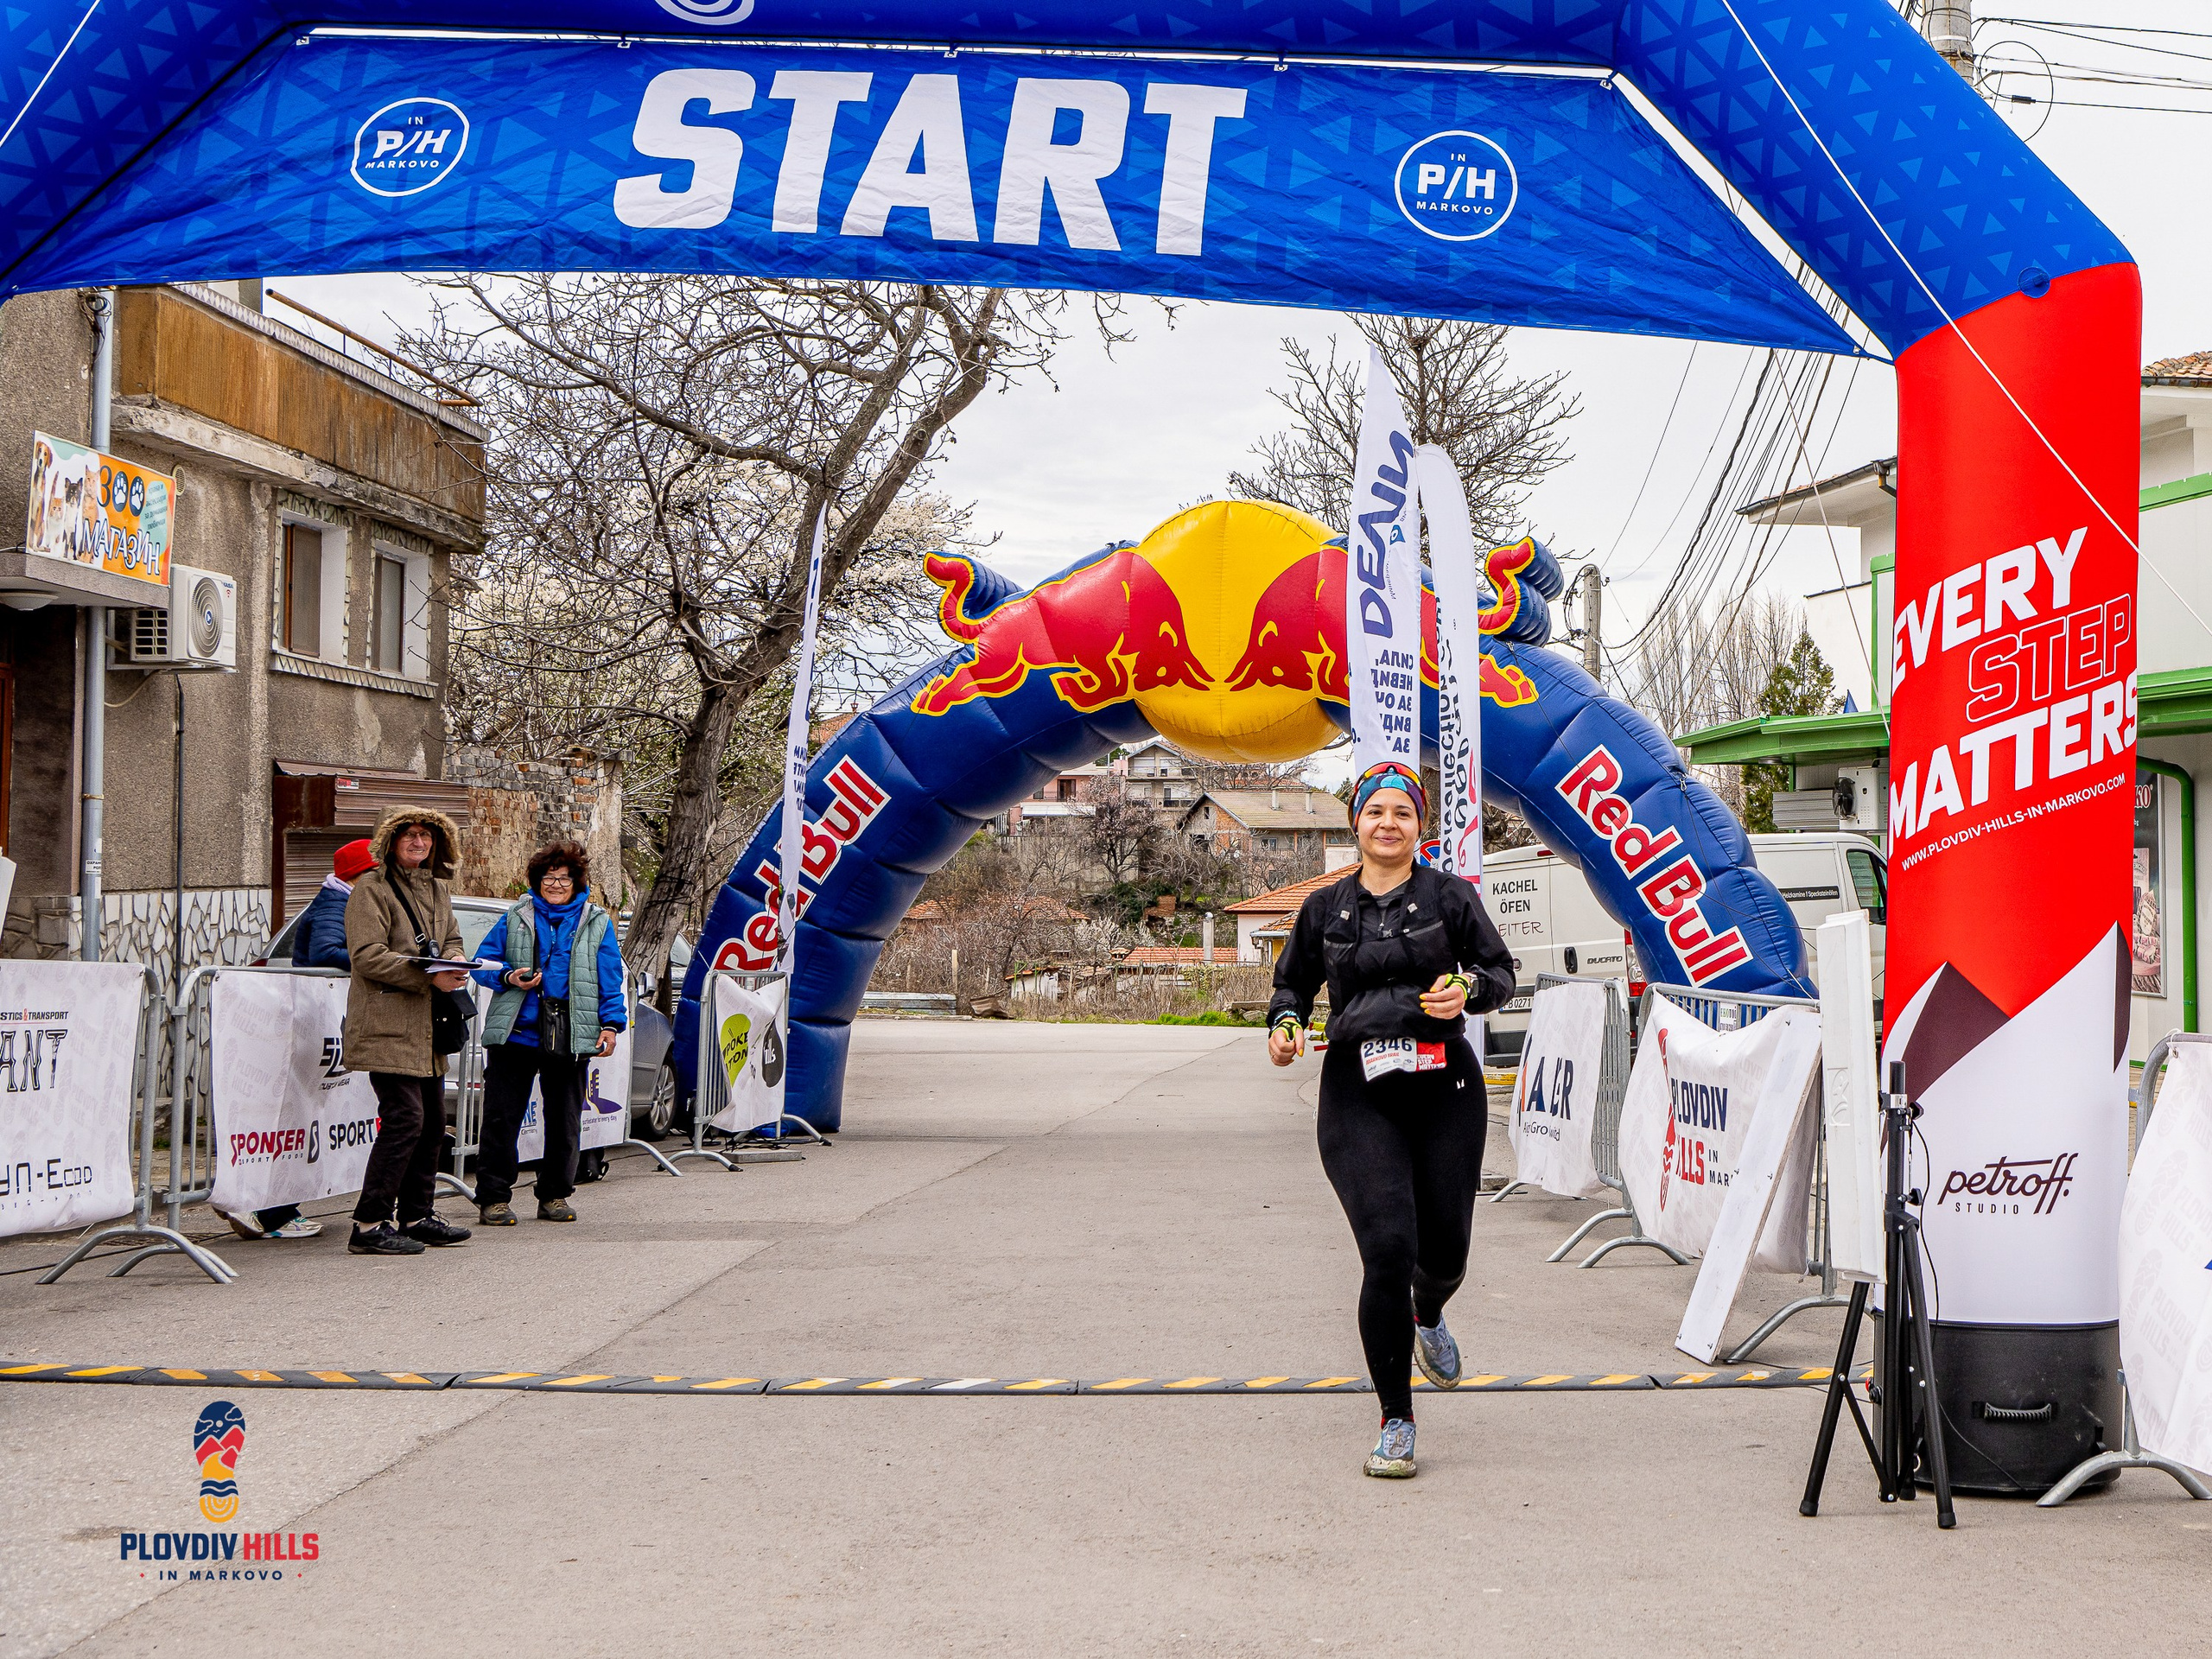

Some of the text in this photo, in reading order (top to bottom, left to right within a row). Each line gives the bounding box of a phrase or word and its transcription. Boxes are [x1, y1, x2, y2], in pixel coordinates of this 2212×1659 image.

[408, 116, 423, 125] IN
[373, 129, 452, 159] P/H
[365, 160, 440, 168] MARKOVO
[613, 68, 1248, 256] START
[1450, 153, 1466, 162] IN
[1417, 162, 1496, 200] P/H
[1416, 200, 1493, 215] MARKOVO
[81, 517, 161, 576] МАГАЗИН
[1892, 525, 2088, 697] EVERY
[1967, 594, 2131, 722] STEP
[1889, 668, 2138, 860] MATTERS
[777, 757, 888, 882] Bull
[1902, 772, 2126, 871] WWW.PLOVDIV-HILLS-IN-MARKOVO.COM
[1558, 747, 1751, 985] Red Bull
[1492, 880, 1538, 895] KACHEL
[1500, 899, 1530, 913] ÖFEN
[1498, 921, 1543, 937] EITER
[1586, 956, 1623, 964] DUCATO
[1514, 997, 1530, 1008] 0271
[1363, 1038, 1413, 1058] 2346
[1366, 1053, 1388, 1065] MARKOVO
[1670, 1077, 1728, 1132] PLOVDIV
[231, 1128, 306, 1167] SPONSER
[1708, 1149, 1719, 1163] IN
[242, 1155, 270, 1165] SPORT
[1709, 1170, 1733, 1187] MAR
[1937, 1153, 2079, 1215] petroff.
[1955, 1202, 2019, 1215] STUDIO
